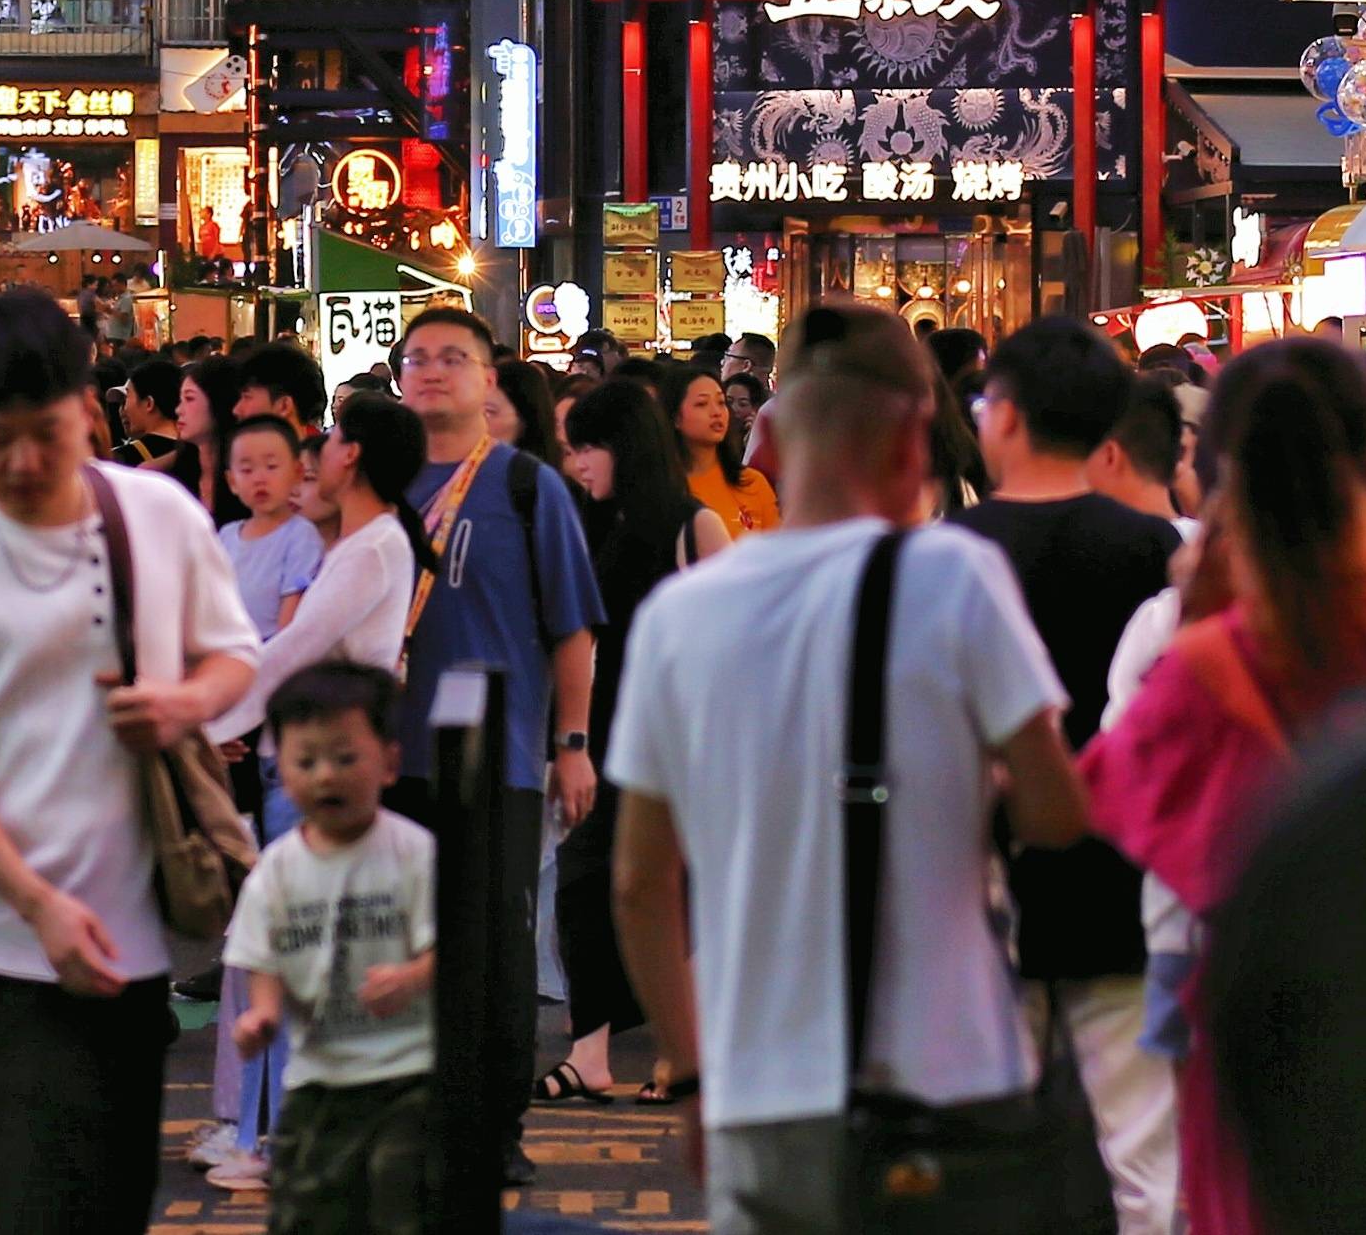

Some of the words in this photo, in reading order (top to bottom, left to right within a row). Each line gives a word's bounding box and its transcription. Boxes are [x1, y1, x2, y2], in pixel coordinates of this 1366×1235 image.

[709, 161, 848, 202] 贵州小吃
[861, 161, 937, 201] 酸汤
[951, 161, 1025, 201] 烧烤
[326, 295, 396, 355] 瓦猫
